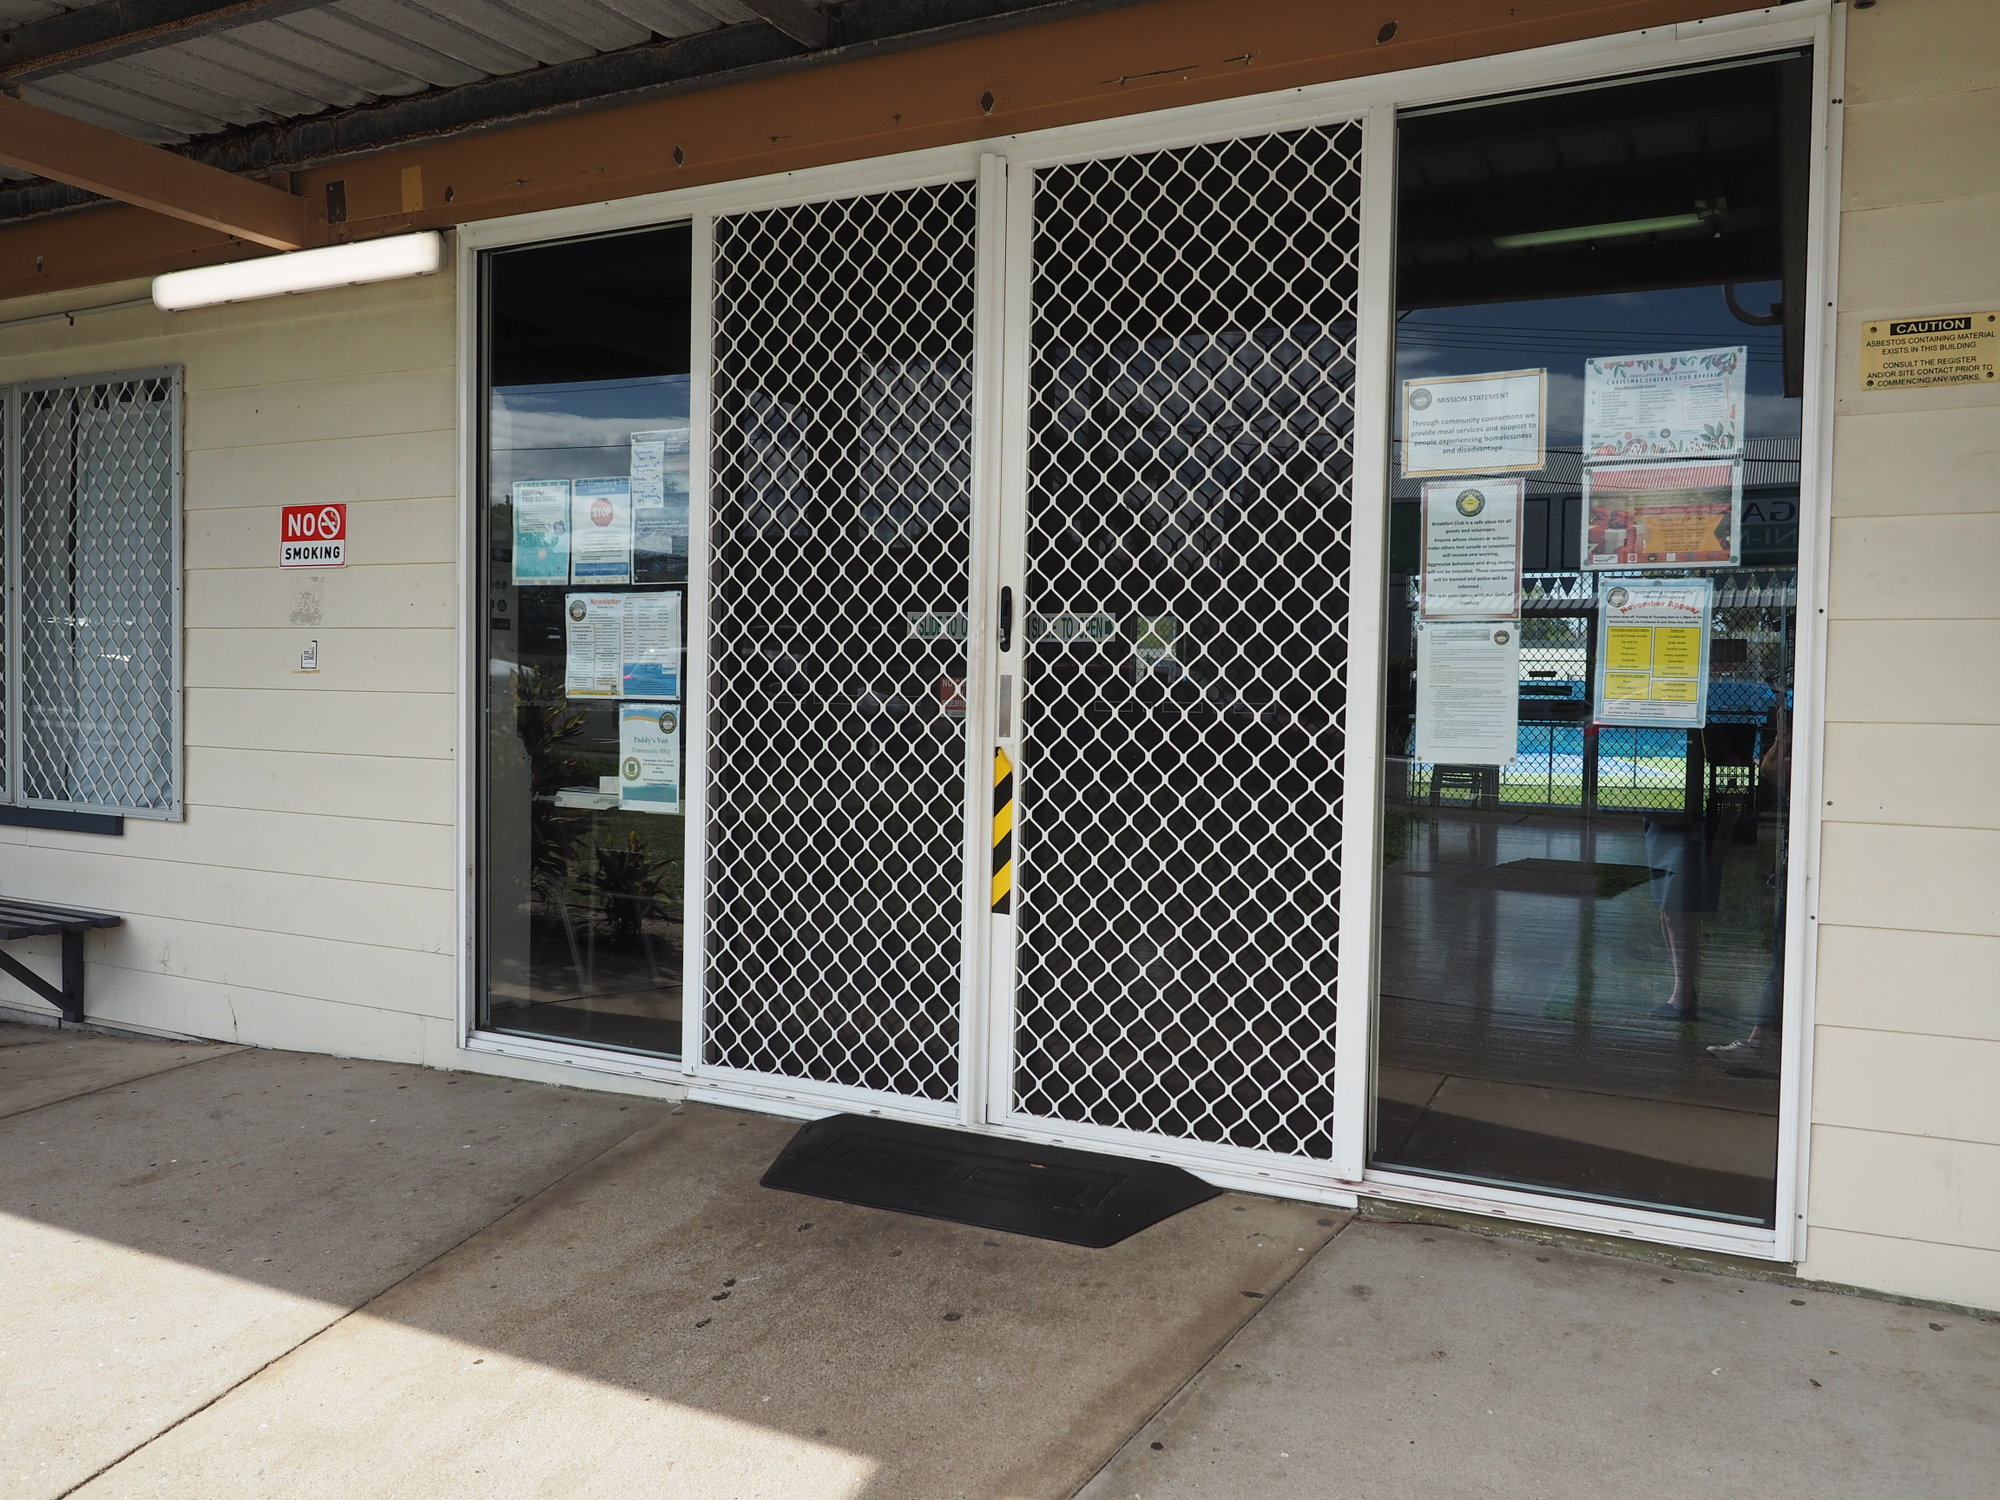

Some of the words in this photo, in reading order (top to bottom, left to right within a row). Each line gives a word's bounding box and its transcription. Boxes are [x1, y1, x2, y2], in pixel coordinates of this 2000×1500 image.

[1896, 319, 1965, 334] CAUTION
[1866, 338, 1906, 347] ASBESTOS
[1908, 334, 1956, 344] CONTAINING
[1958, 331, 1996, 340] MATERIAL
[1882, 347, 1909, 355] EXISTS
[1940, 342, 1978, 350] BUILDING.
[1883, 360, 1919, 369] CONSULT
[1938, 356, 1977, 365] REGISTER
[1867, 371, 1896, 379] AND/OR
[1917, 367, 1953, 375] CONTACT
[1877, 378, 1930, 387] COMMENCING
[1437, 396, 1467, 404] MISSION
[1469, 392, 1509, 401] STATEMENT
[1441, 417, 1479, 425] community
[1482, 414, 1523, 422] connections
[1411, 429, 1436, 438] provide
[1500, 423, 1526, 432] support
[1439, 436, 1482, 446] experiencing
[1484, 432, 1533, 442] homelessness
[1457, 445, 1503, 454] disadvantage
[592, 507, 612, 518] STOP
[288, 513, 315, 537] NO
[285, 546, 340, 560] SMOKING
[1619, 600, 1665, 614] November
[1062, 617, 1073, 638] TO
